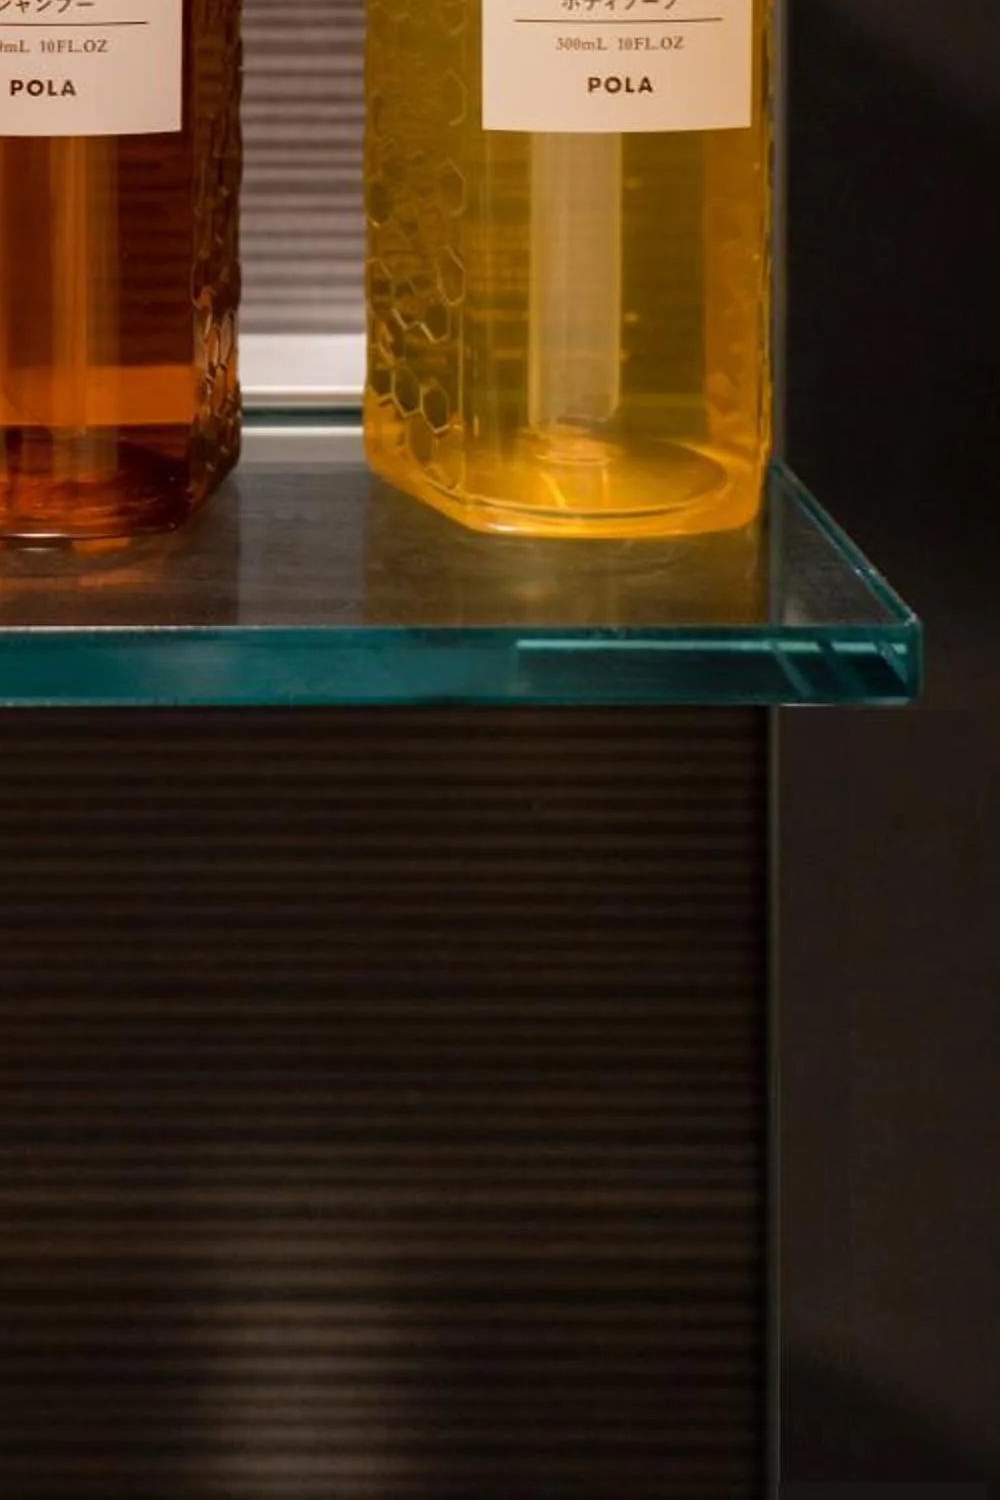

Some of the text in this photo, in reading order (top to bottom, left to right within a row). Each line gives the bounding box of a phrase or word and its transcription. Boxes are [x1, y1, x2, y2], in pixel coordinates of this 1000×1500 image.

[555, 36, 610, 52] 300mL
[10, 79, 76, 97] POLA
[587, 76, 653, 94] POLA
